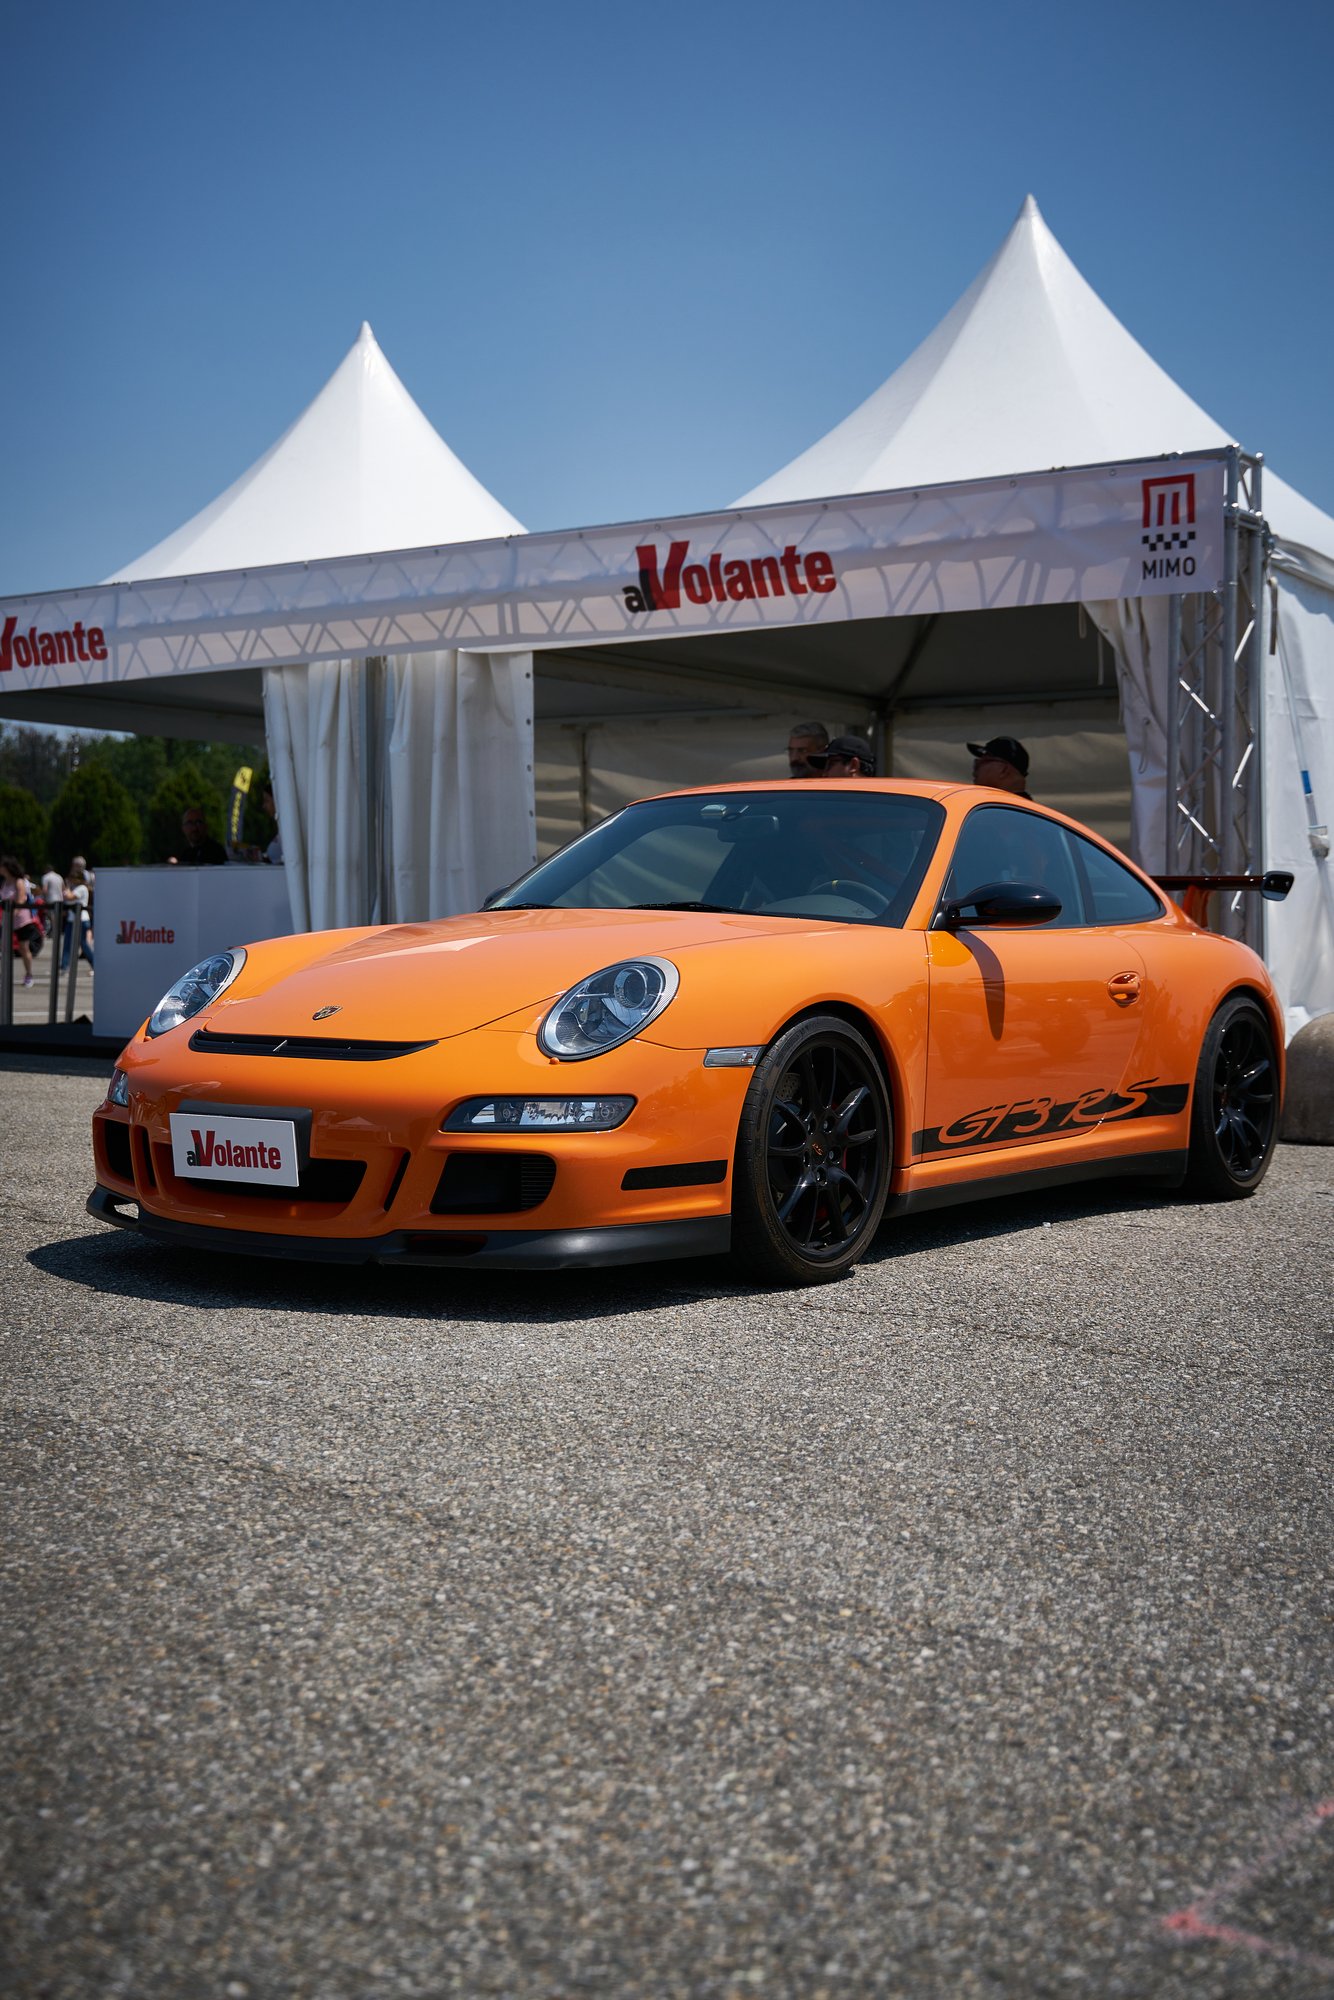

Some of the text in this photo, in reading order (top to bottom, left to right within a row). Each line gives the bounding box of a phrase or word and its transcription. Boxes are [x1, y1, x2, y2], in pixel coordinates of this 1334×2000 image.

[1142, 557, 1196, 580] MIMO
[938, 1077, 1160, 1144] GT3 RS
